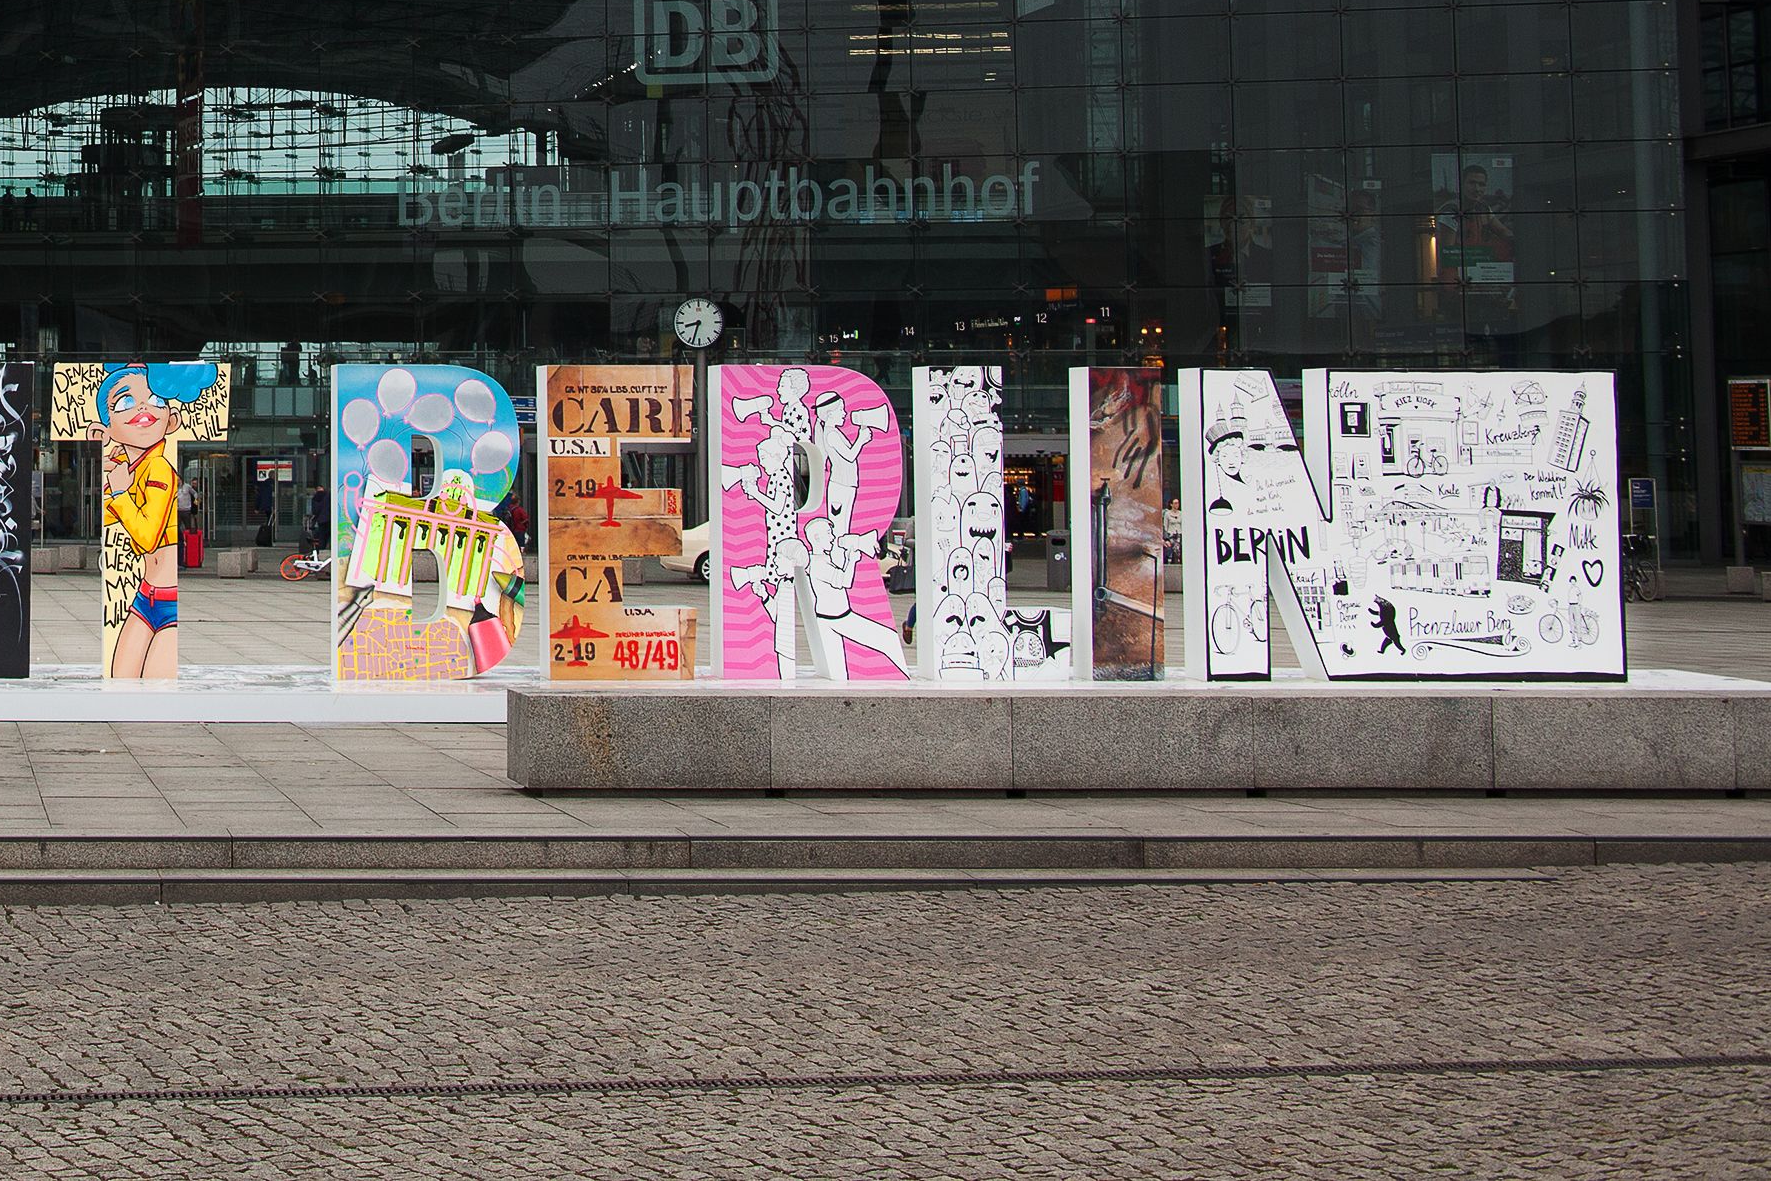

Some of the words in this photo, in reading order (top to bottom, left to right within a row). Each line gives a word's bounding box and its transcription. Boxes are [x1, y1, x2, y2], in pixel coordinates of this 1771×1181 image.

[652, 0, 762, 69] DB
[397, 168, 563, 227] Berlin
[609, 160, 1041, 233] Hauptbahnhof
[1035, 312, 1048, 324] 12
[1100, 306, 1111, 318] 11
[904, 326, 915, 336] 14
[954, 321, 966, 332] 13
[829, 334, 839, 343] 15
[55, 362, 105, 394] DENKEN
[81, 377, 104, 397] MAN
[54, 391, 86, 413] WAS
[180, 370, 227, 416] AUSSEHEN
[204, 391, 228, 417] MAN
[1394, 395, 1413, 409] KIEZ
[1415, 395, 1439, 409] KIOSK
[552, 397, 694, 434] CARE
[550, 439, 606, 455] U.S.A.
[555, 478, 597, 498] 2-19
[105, 549, 133, 572] WEN
[105, 568, 142, 601] MAN
[1409, 607, 1482, 637] Prenzlauer
[1486, 610, 1514, 645] Berg
[554, 642, 596, 661] 2-19
[613, 640, 679, 671] 48/49
